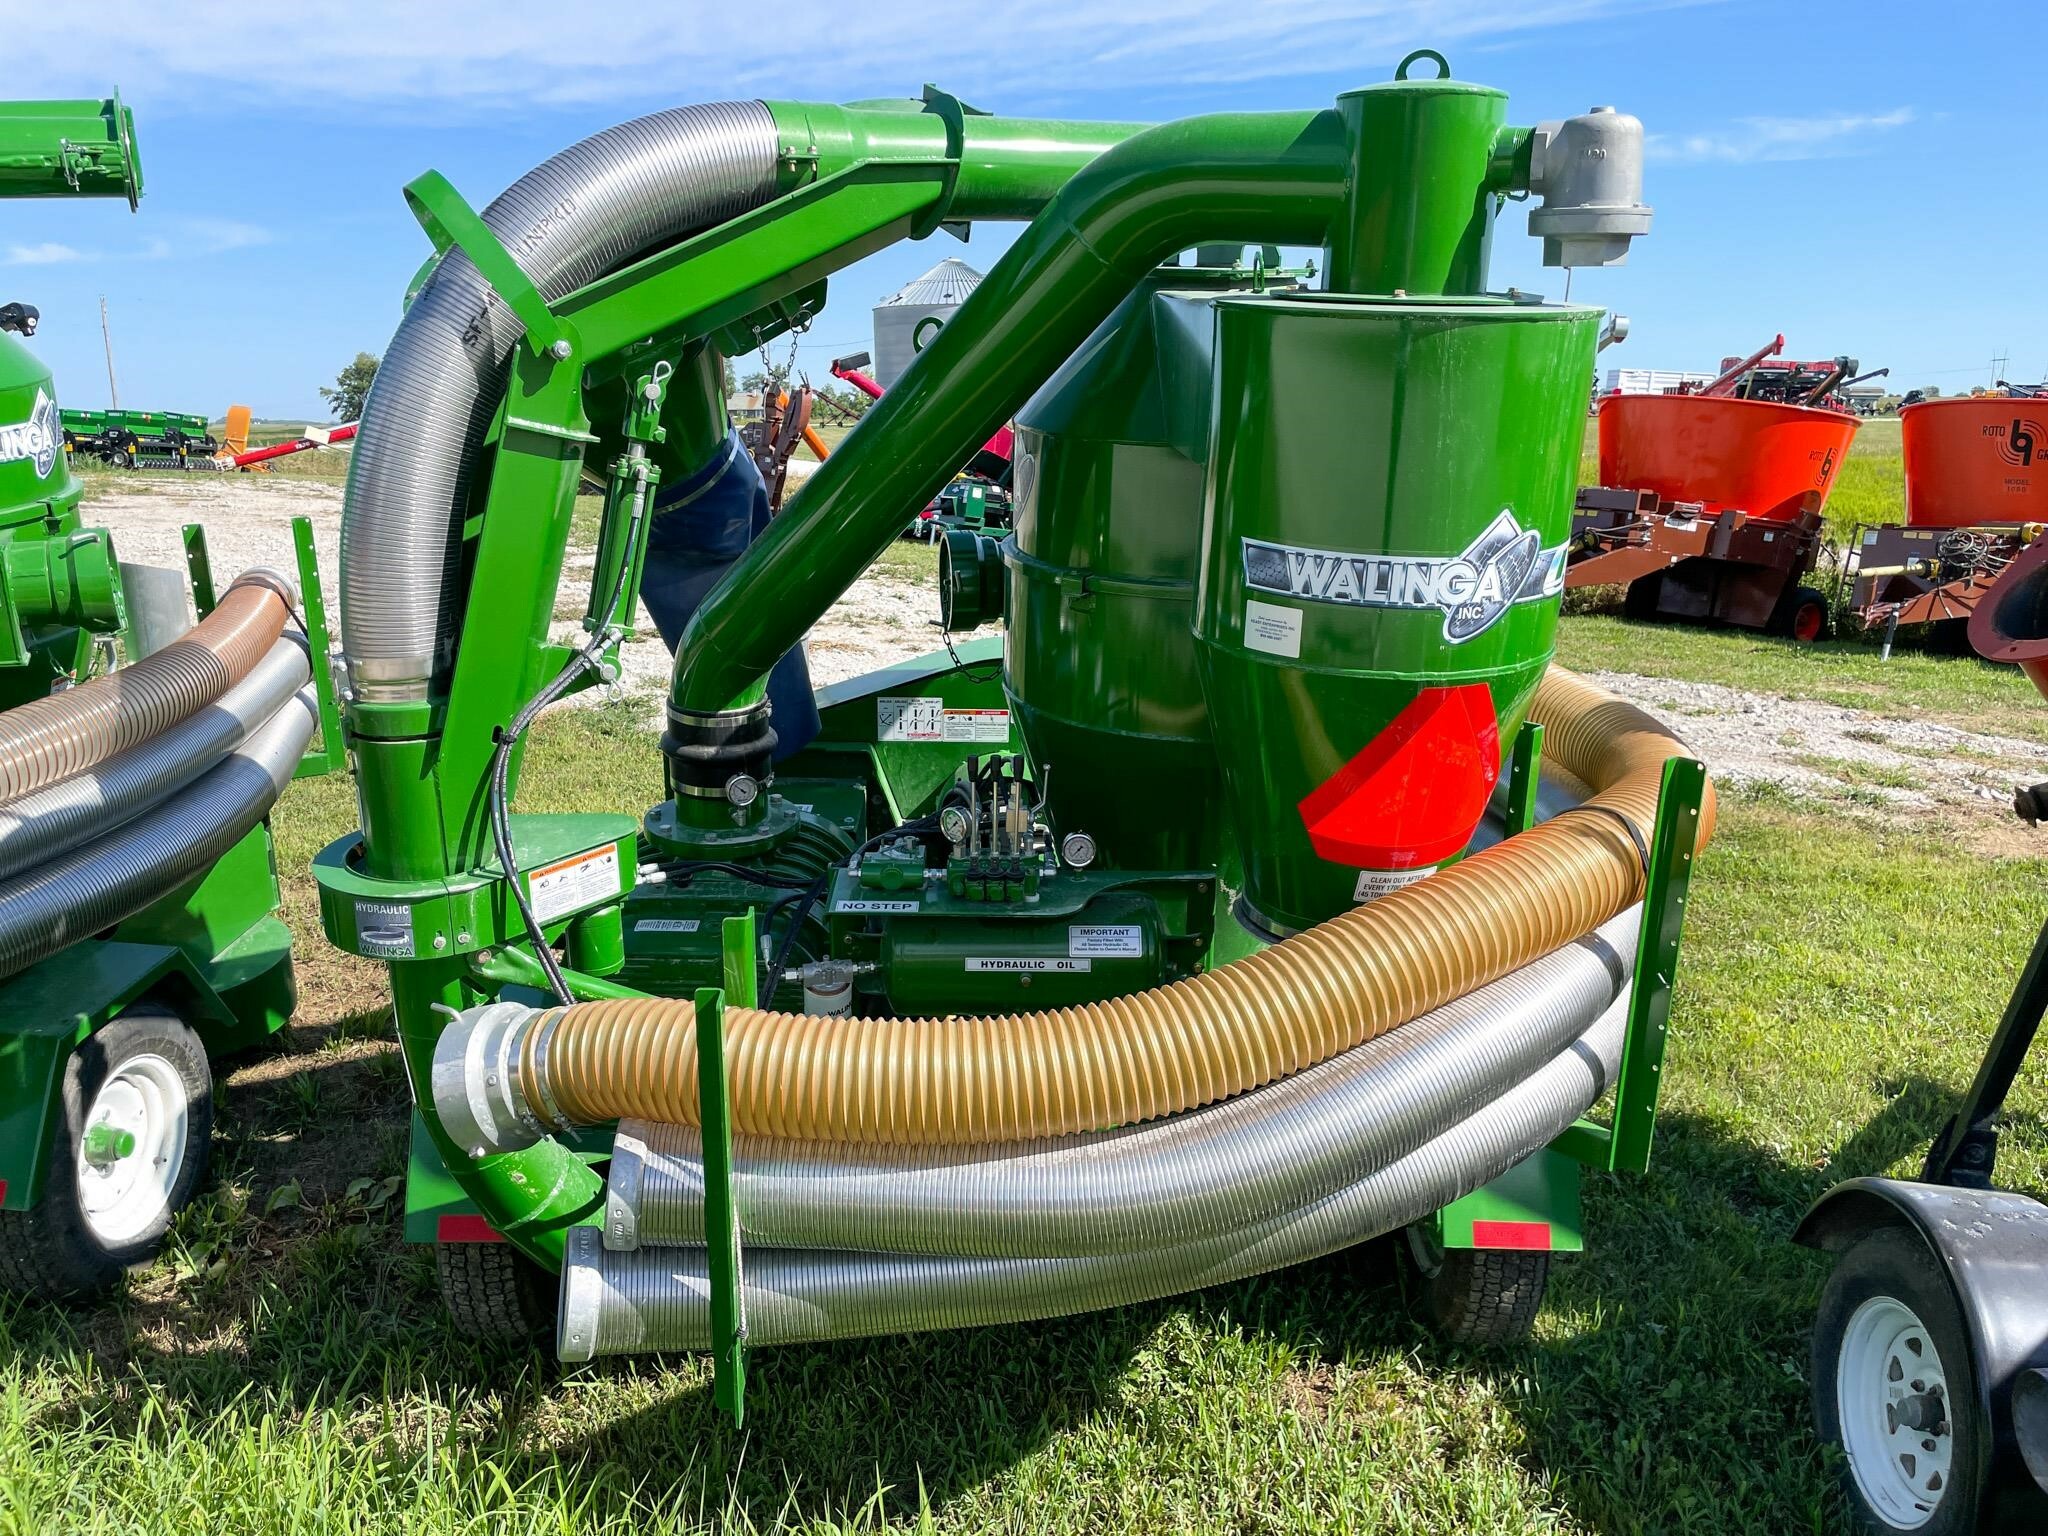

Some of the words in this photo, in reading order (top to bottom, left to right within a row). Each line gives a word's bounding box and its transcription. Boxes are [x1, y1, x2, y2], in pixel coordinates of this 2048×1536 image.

[1983, 425, 2006, 437] ROTO
[1286, 550, 1504, 604] WALINGA
[1458, 607, 1485, 619] INC.
[1370, 876, 1392, 884] CLEAN
[355, 902, 409, 914] HYDRAULIC
[842, 902, 866, 910] NO
[871, 902, 912, 910] STEP
[360, 944, 414, 957] WALINGA
[980, 960, 1046, 969] HYDRAULIC
[1057, 960, 1075, 969] OIL
